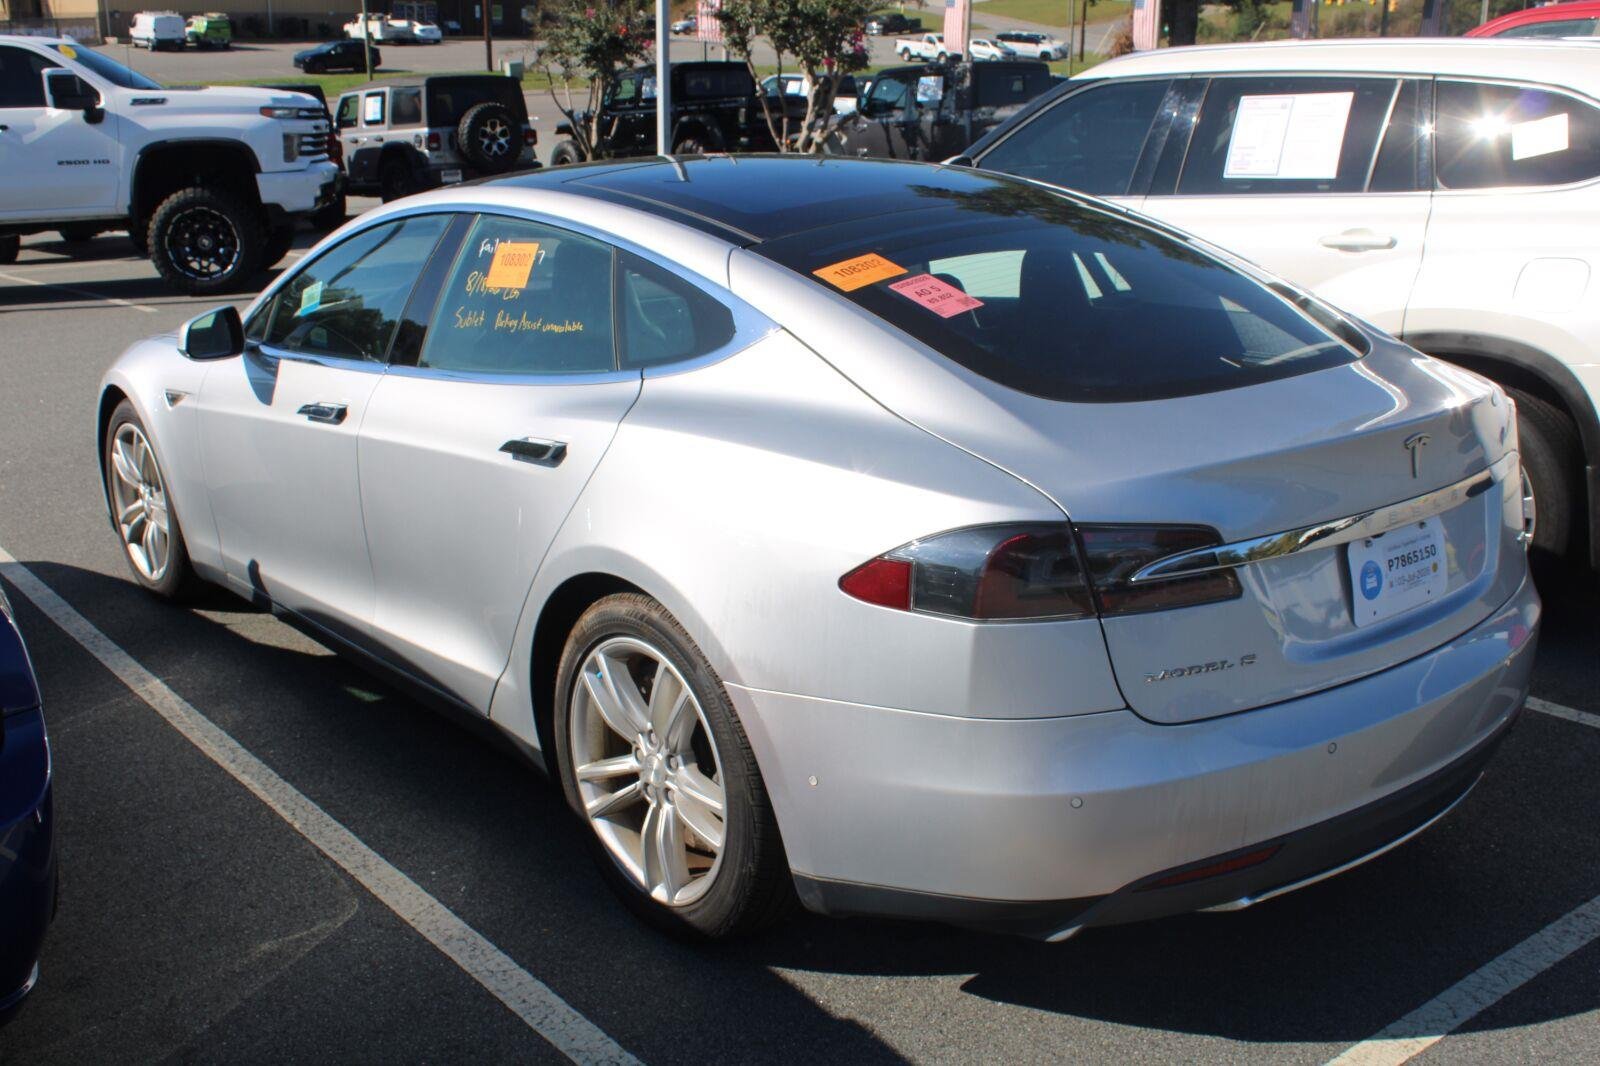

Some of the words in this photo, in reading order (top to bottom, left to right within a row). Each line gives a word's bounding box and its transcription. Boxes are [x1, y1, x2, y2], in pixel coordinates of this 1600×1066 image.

[832, 257, 886, 279] 108302
[454, 306, 486, 329] Sublet
[494, 310, 519, 333] Parking
[517, 312, 542, 331] Assist
[541, 319, 584, 333] unavailable
[1387, 543, 1437, 572] P7865150
[1143, 659, 1235, 684] MODEL
[1240, 653, 1257, 667] S
